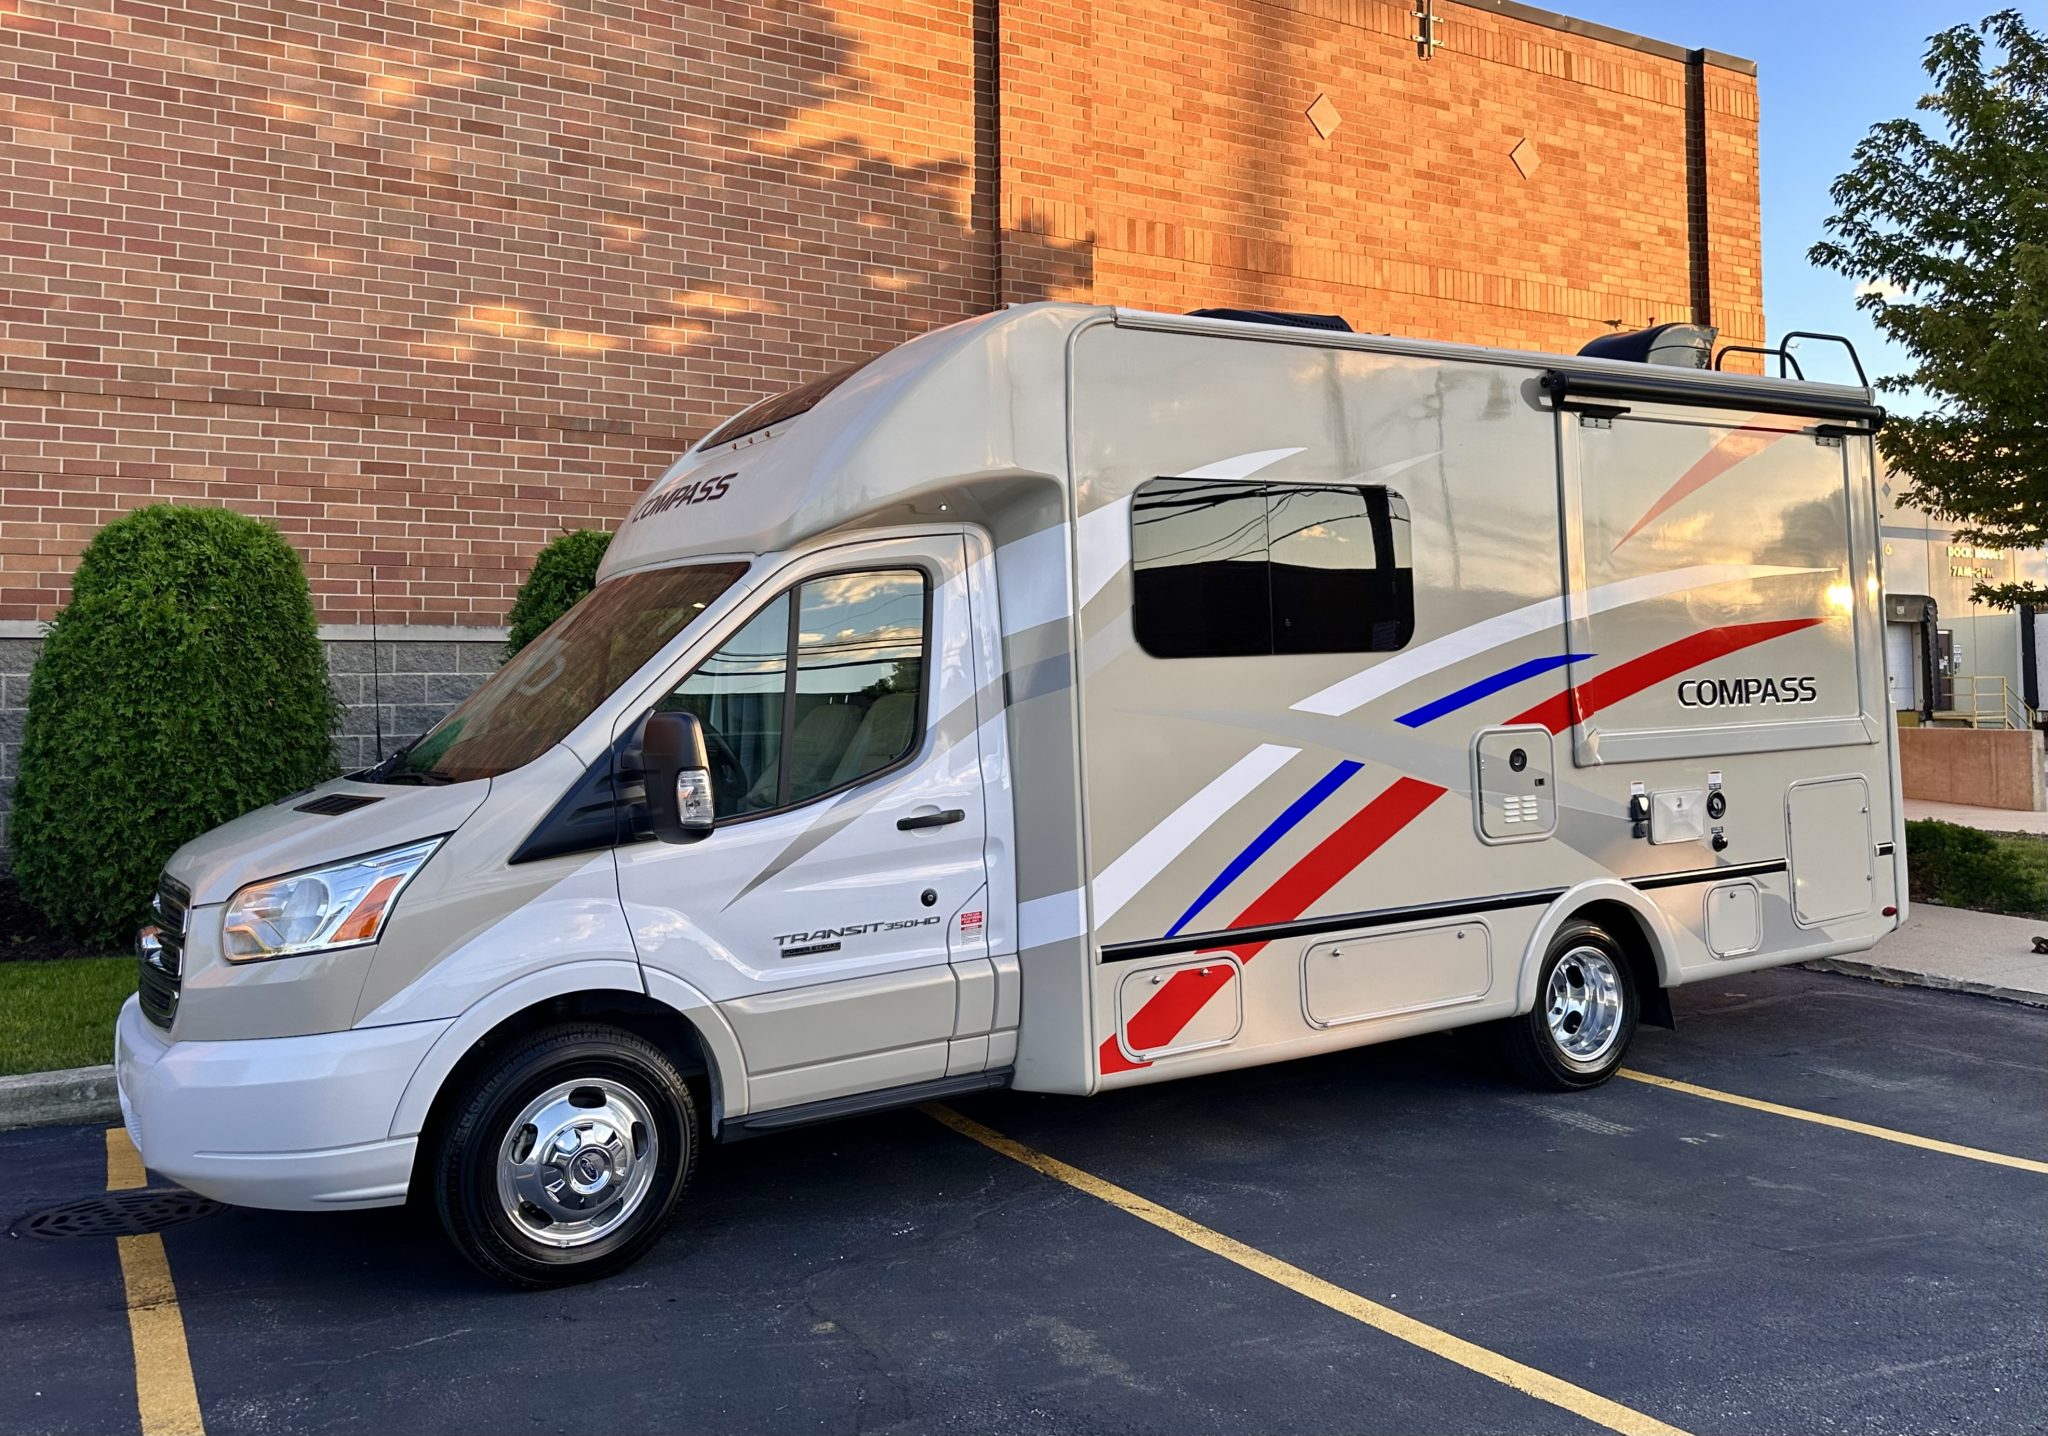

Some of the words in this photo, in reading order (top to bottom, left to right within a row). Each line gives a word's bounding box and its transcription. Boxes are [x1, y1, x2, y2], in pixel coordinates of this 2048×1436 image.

[632, 472, 739, 524] COMPASS
[1677, 676, 1817, 708] COMPASS
[773, 922, 884, 946] TRANSIT
